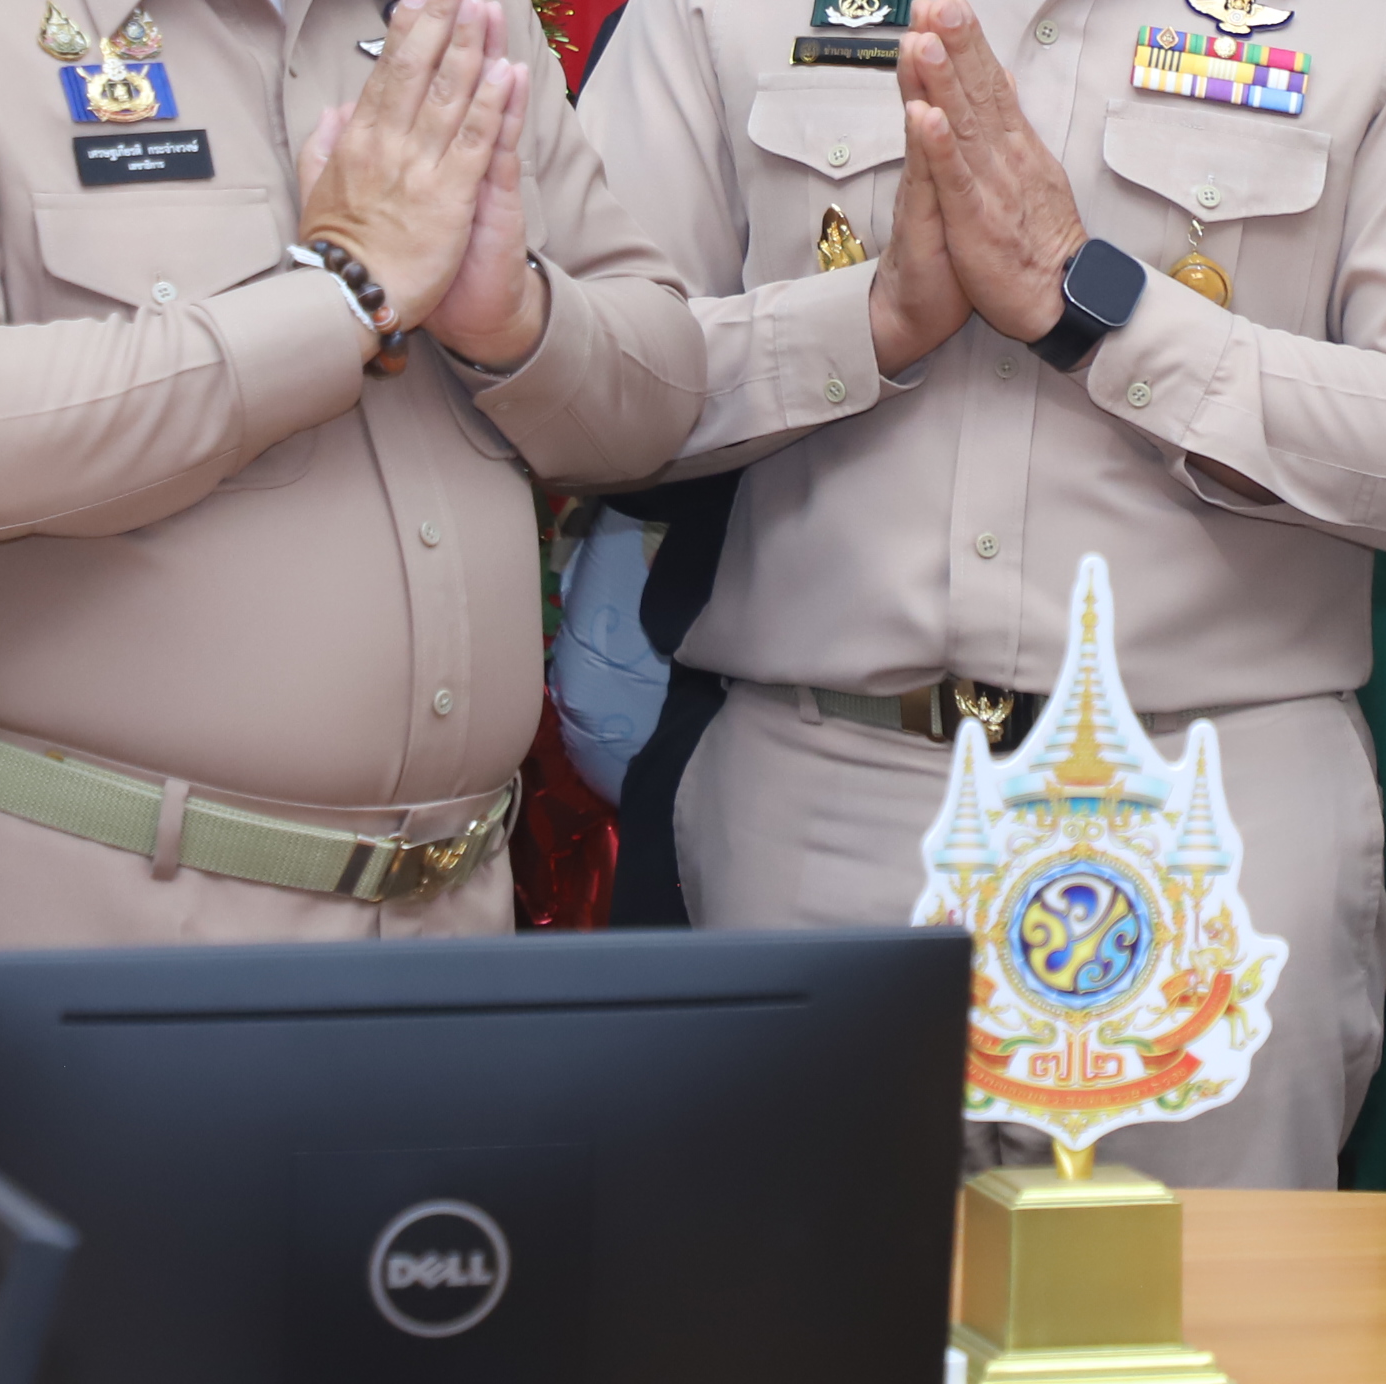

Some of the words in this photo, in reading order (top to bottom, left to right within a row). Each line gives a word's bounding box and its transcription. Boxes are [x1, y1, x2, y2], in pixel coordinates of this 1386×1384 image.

[857, 46, 900, 60] บุญประเสริ
[387, 1249, 494, 1290] DELL
